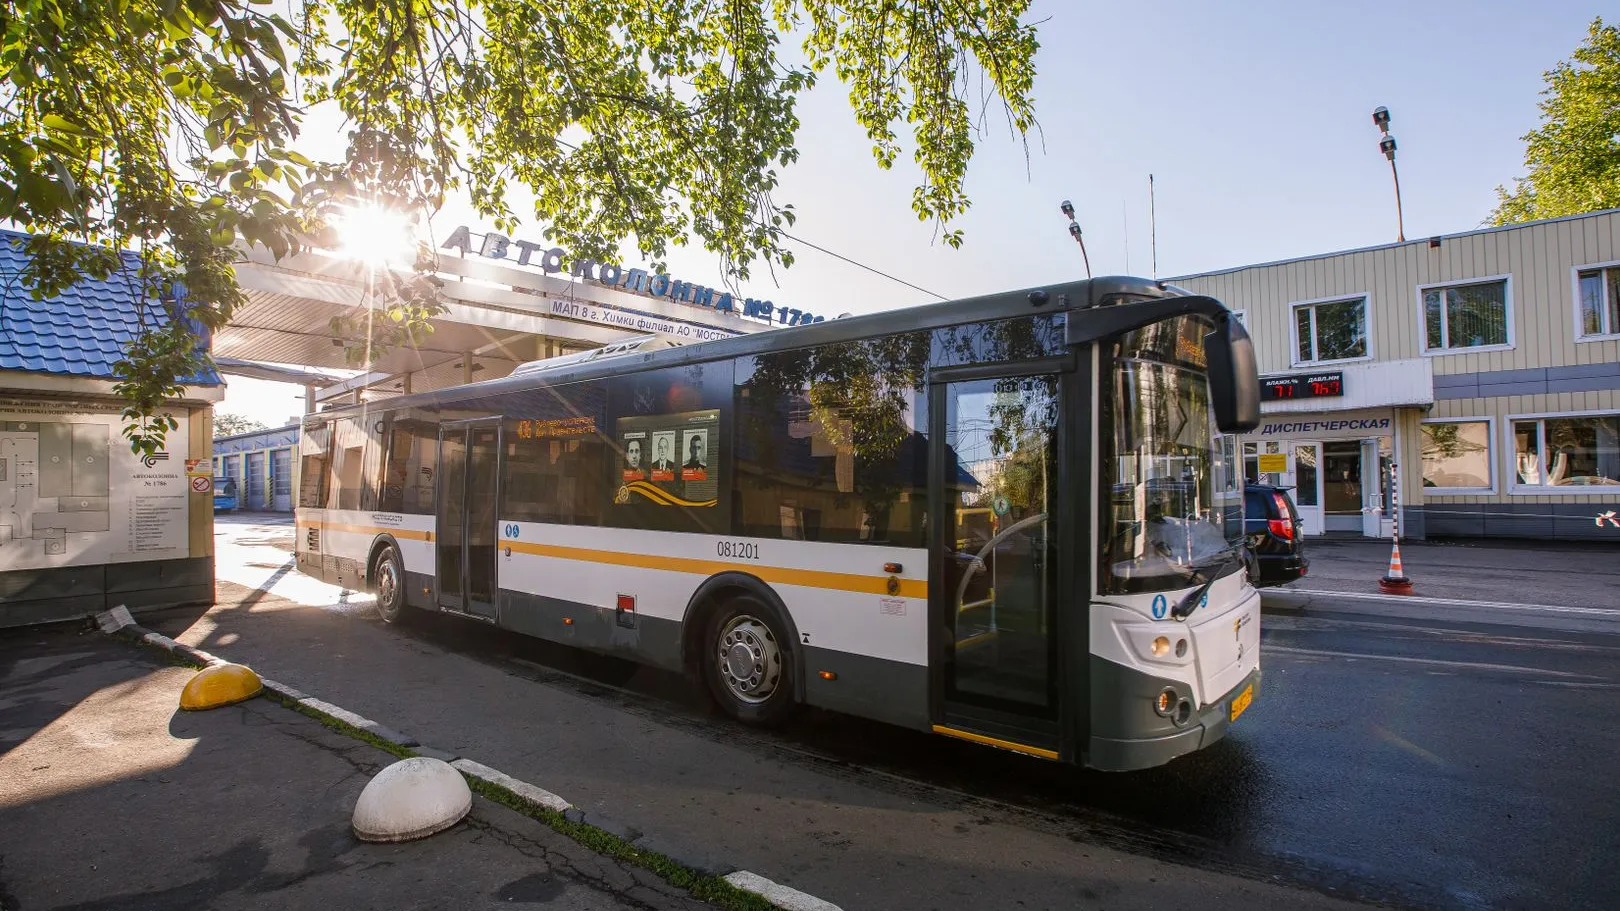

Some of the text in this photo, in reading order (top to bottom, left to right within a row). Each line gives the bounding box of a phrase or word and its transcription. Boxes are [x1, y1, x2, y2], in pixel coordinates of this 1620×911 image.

[552, 301, 579, 316] МАП
[582, 307, 589, 318] 8
[602, 310, 635, 326] Химки
[637, 319, 674, 334] филиал
[676, 325, 690, 337] АО
[743, 298, 775, 321] №
[1261, 418, 1390, 436] ДИСПЕТЧЕРСКАЯ
[717, 541, 760, 560] 081201
